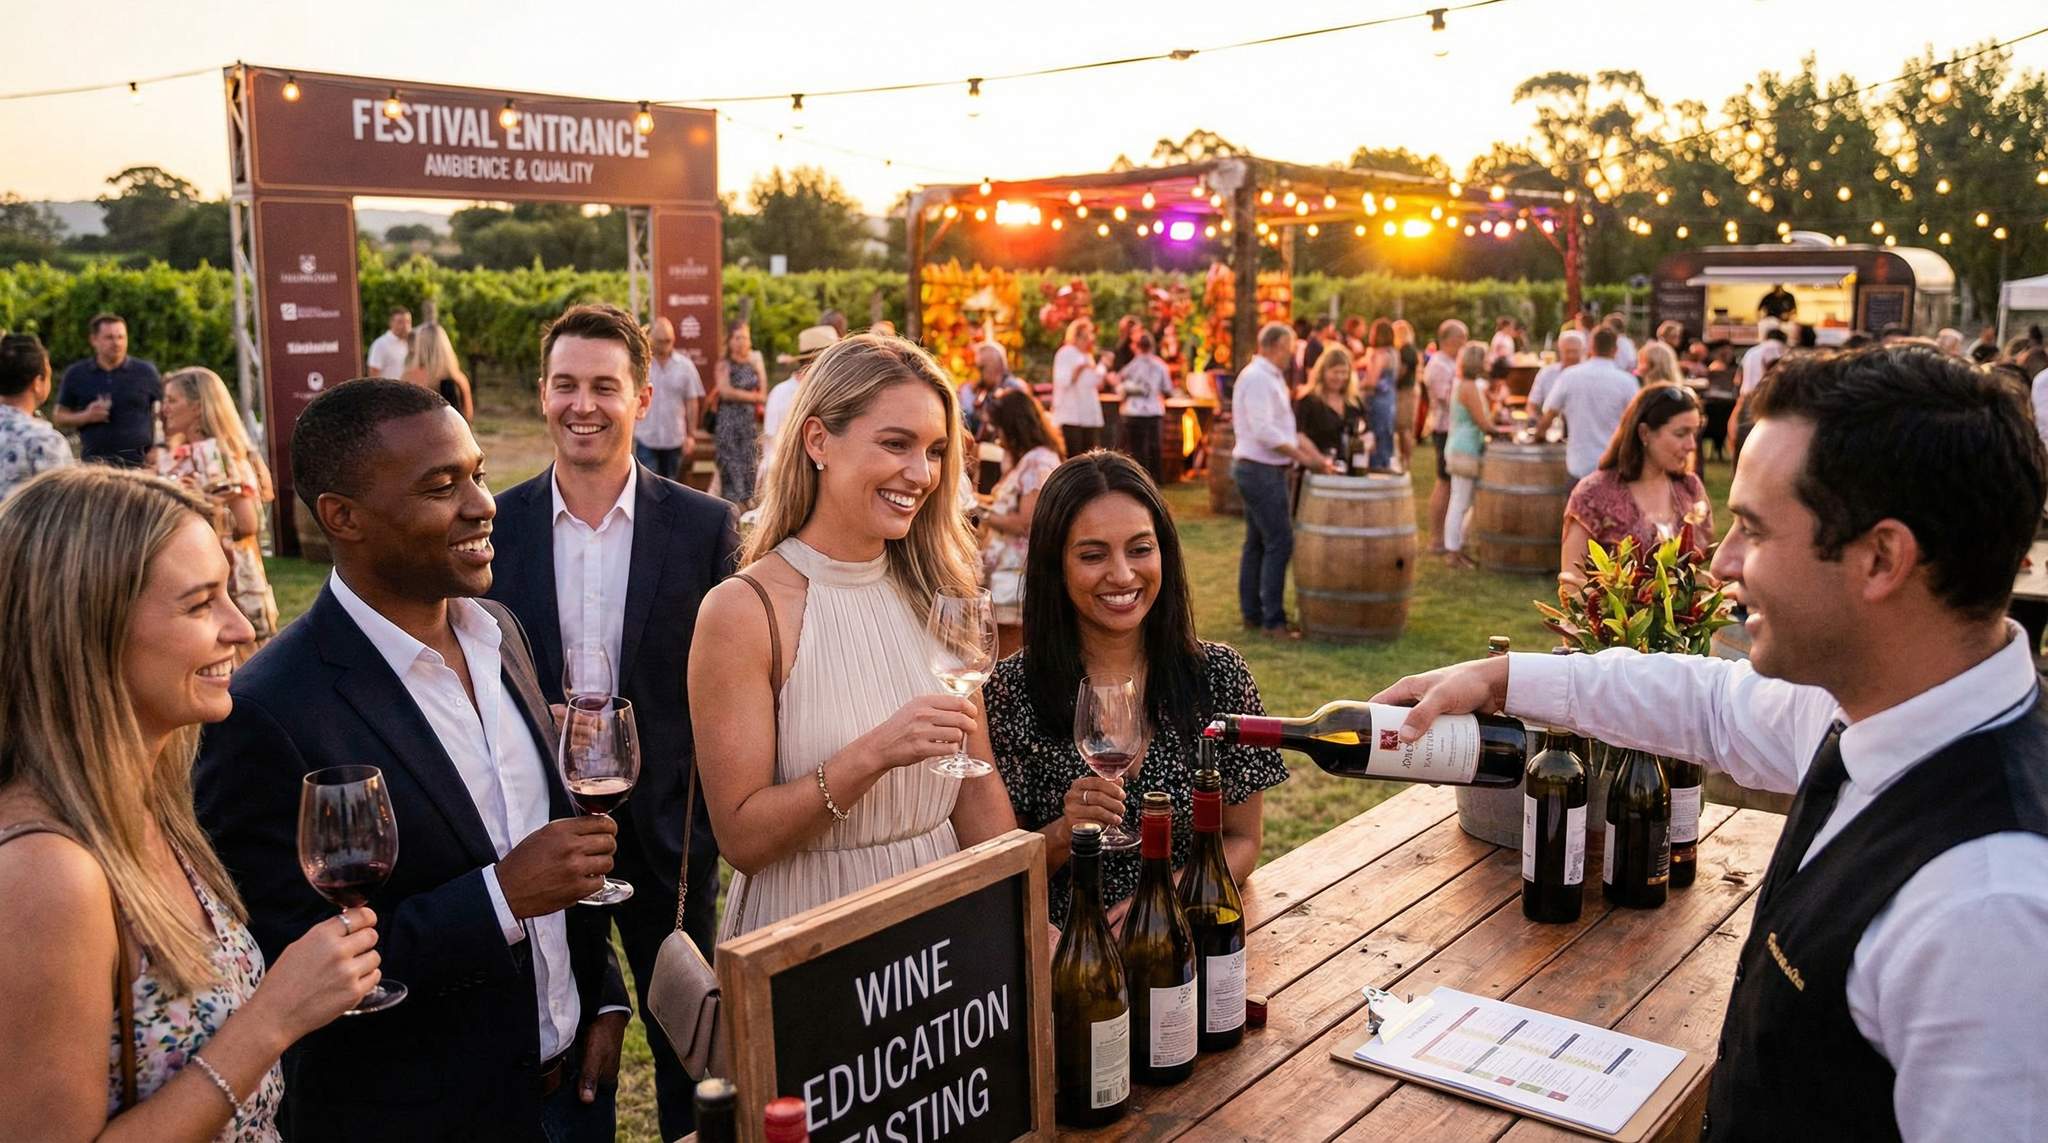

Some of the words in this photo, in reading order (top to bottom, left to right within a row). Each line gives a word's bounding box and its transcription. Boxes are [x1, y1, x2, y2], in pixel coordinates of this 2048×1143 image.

[352, 98, 499, 148] FESTIVAL
[506, 110, 649, 159] ENTRANCE
[424, 153, 511, 180] AMBIENCE
[514, 157, 528, 181] &
[530, 158, 594, 184] QUALITY
[855, 938, 953, 1026] WINE
[803, 984, 1009, 1132] EDUCATION
[838, 1067, 990, 1143] STING
